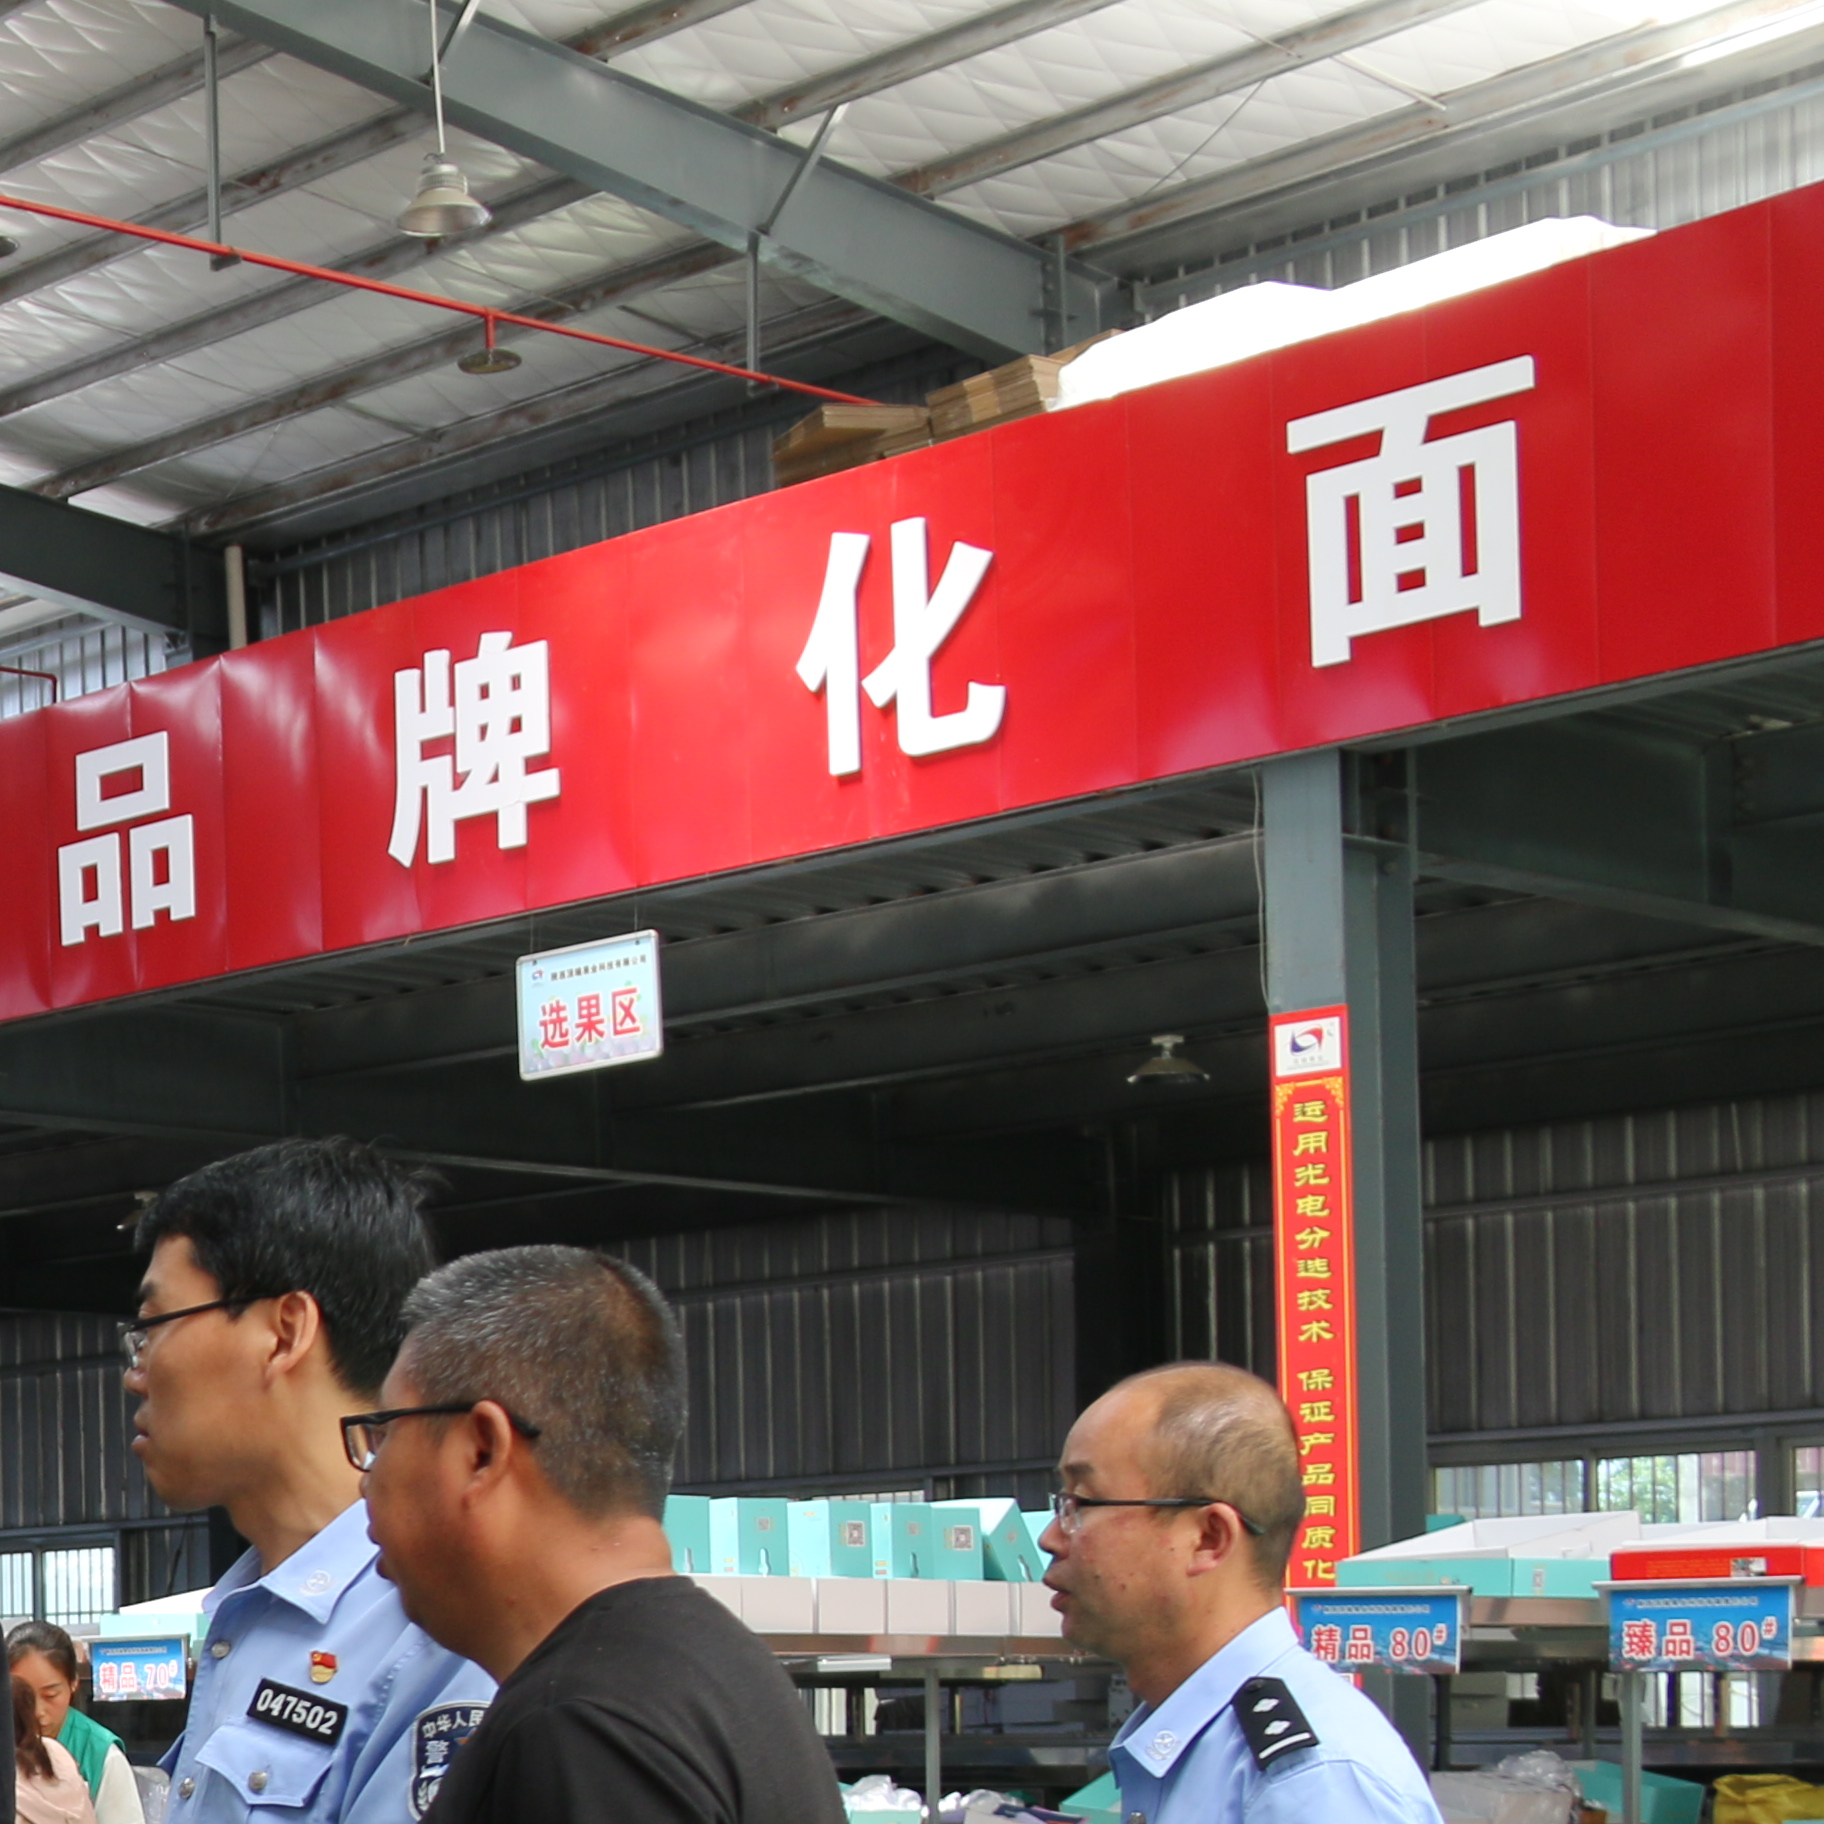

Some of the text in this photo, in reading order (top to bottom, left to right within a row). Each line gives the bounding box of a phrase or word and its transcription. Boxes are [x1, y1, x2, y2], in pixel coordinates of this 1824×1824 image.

[57, 354, 1540, 947] 品牌化面
[539, 987, 641, 1049] 选果区
[1292, 1100, 1334, 1343] 运用光电分选技术
[1298, 1368, 1337, 1582] 保证产品同质化
[1312, 1624, 1374, 1663] 精品
[100, 1662, 137, 1692] 精品
[256, 1688, 338, 1735] 047502
